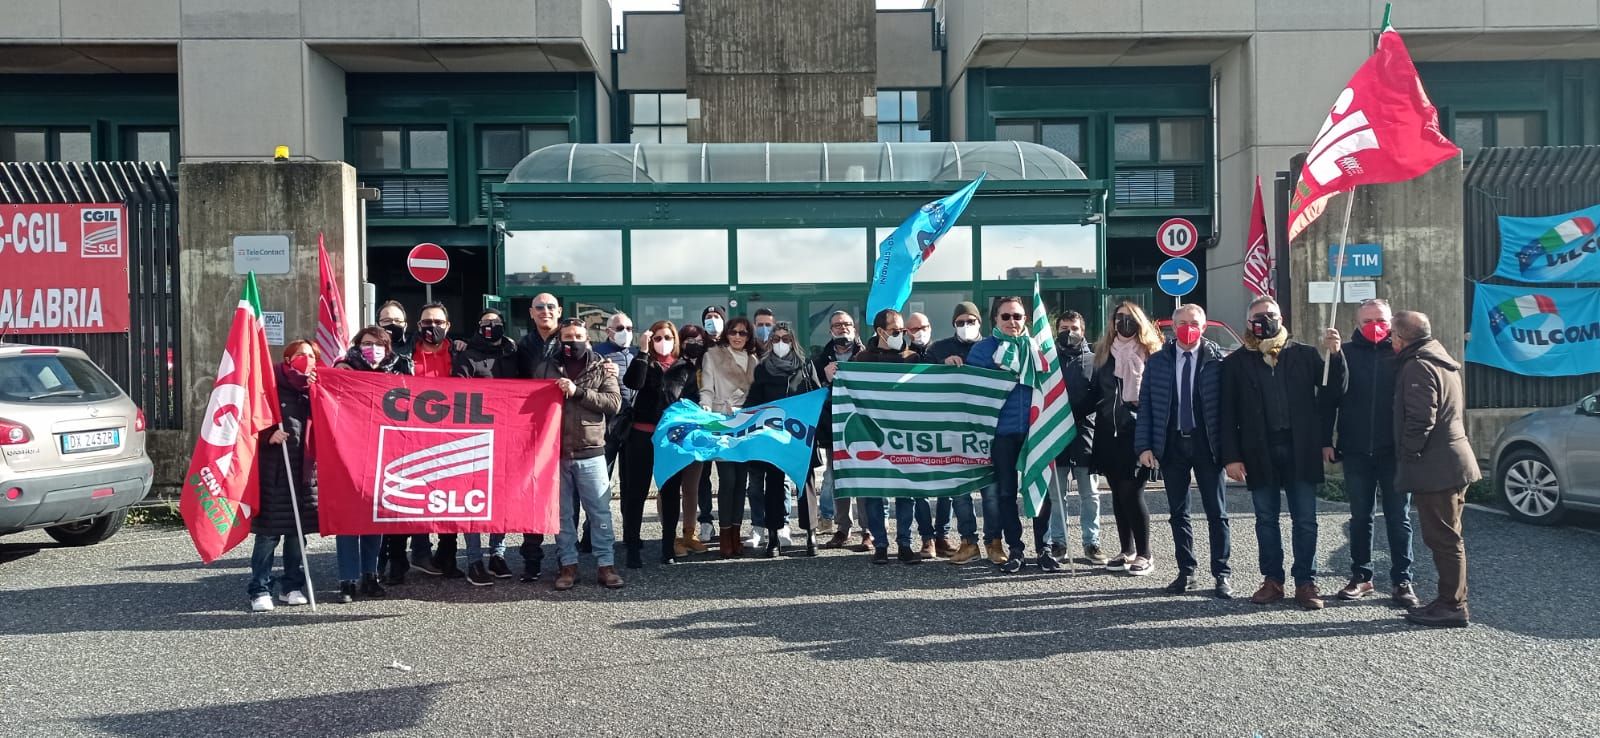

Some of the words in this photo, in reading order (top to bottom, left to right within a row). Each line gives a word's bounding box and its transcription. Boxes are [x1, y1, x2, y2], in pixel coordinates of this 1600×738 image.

[83, 210, 118, 222] CGIL
[1168, 228, 1188, 246] 10
[98, 243, 117, 253] SLC
[246, 248, 285, 256] TeleContact
[1352, 253, 1379, 267] TIM
[1510, 322, 1600, 346] UILCOM
[382, 387, 494, 424] CGIL
[70, 434, 81, 449] DX
[887, 430, 952, 453] CISL
[962, 433, 993, 455] Re
[427, 489, 485, 514] SLC
